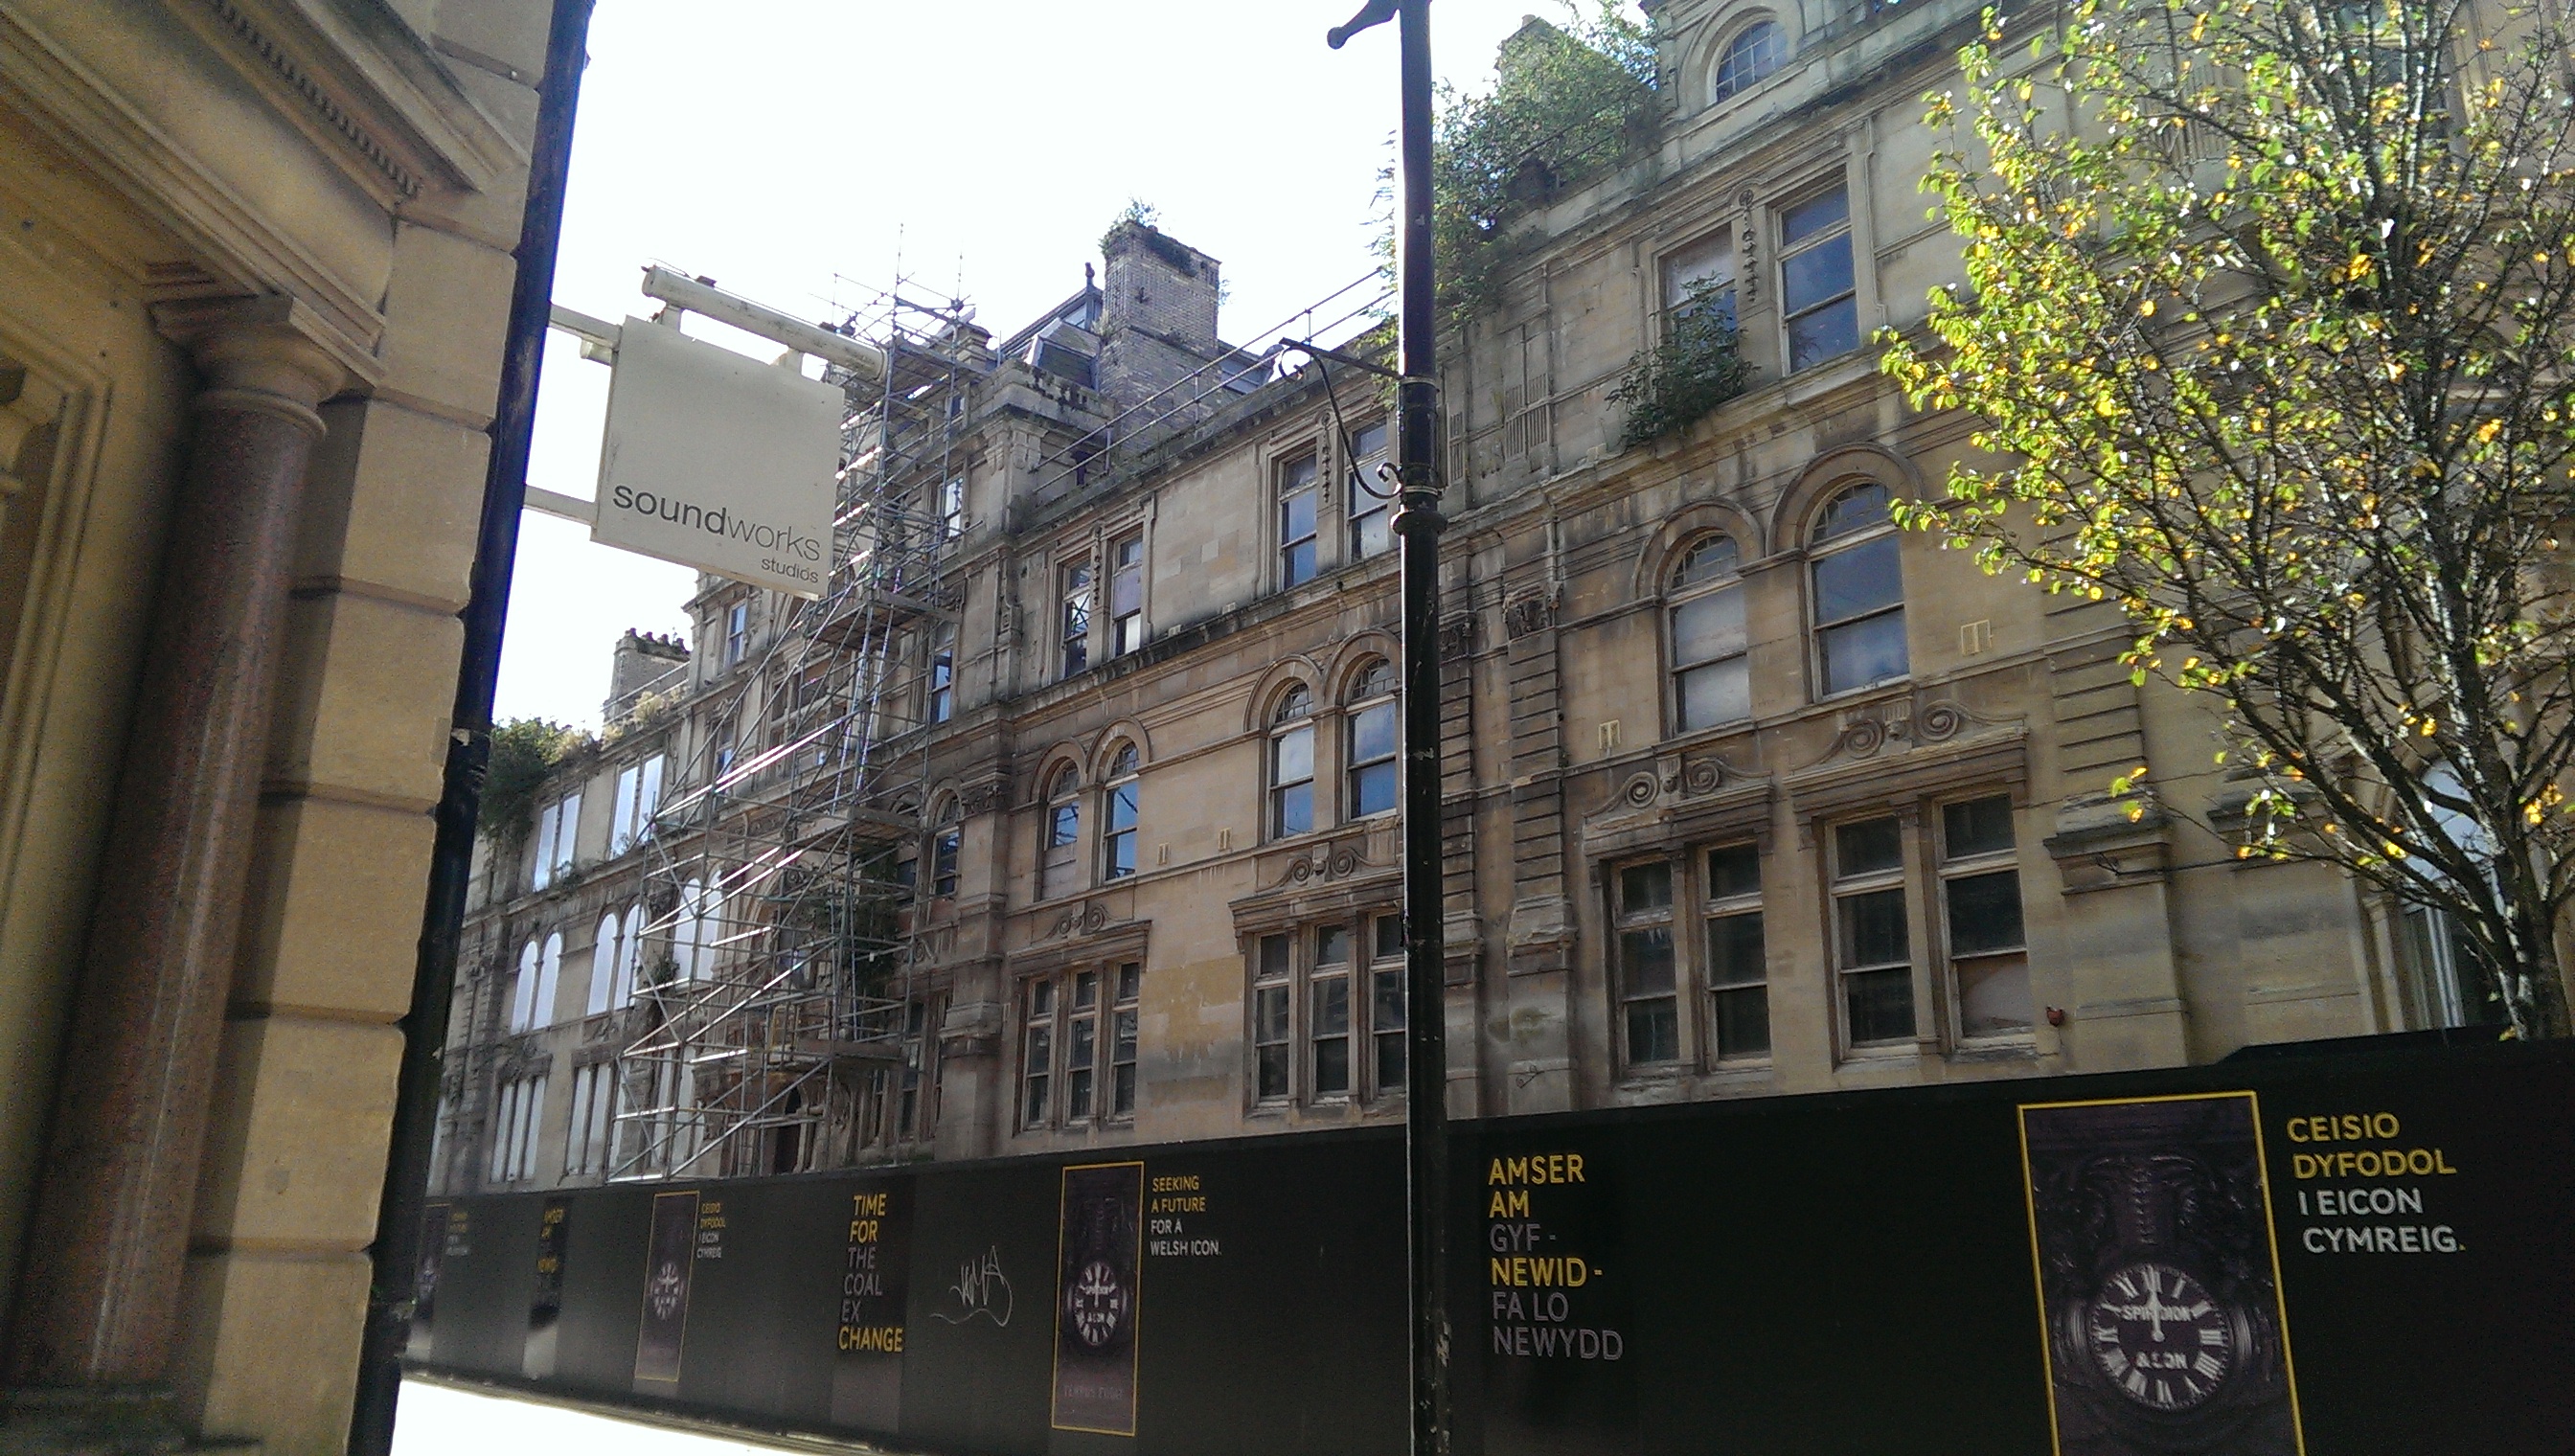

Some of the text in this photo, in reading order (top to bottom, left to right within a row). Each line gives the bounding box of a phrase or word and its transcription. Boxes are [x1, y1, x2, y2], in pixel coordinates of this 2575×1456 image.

[612, 485, 821, 561] soundworks
[762, 557, 819, 583] studios
[2286, 1111, 2401, 1143] CEISIO
[1488, 1153, 1585, 1186] AMSER
[2292, 1148, 2458, 1179] DYFODOL
[1151, 1174, 1199, 1193] SEEKING
[854, 1193, 888, 1217] TIME
[1151, 1195, 1206, 1214] A FUTURE
[1489, 1190, 1530, 1218] AM
[2298, 1187, 2424, 1216] I EICON
[849, 1219, 878, 1243] FOR
[1151, 1217, 1183, 1235] FOR A
[2302, 1224, 2467, 1254] CYMREIG.
[848, 1246, 877, 1269] THE
[1150, 1239, 1222, 1256] WELSH ICON.
[844, 1273, 883, 1296] COAL
[841, 1299, 862, 1323] EX
[1493, 1291, 1569, 1323] FA LO
[838, 1326, 904, 1353] CHANGE
[1493, 1325, 1624, 1361] NEWYDD
